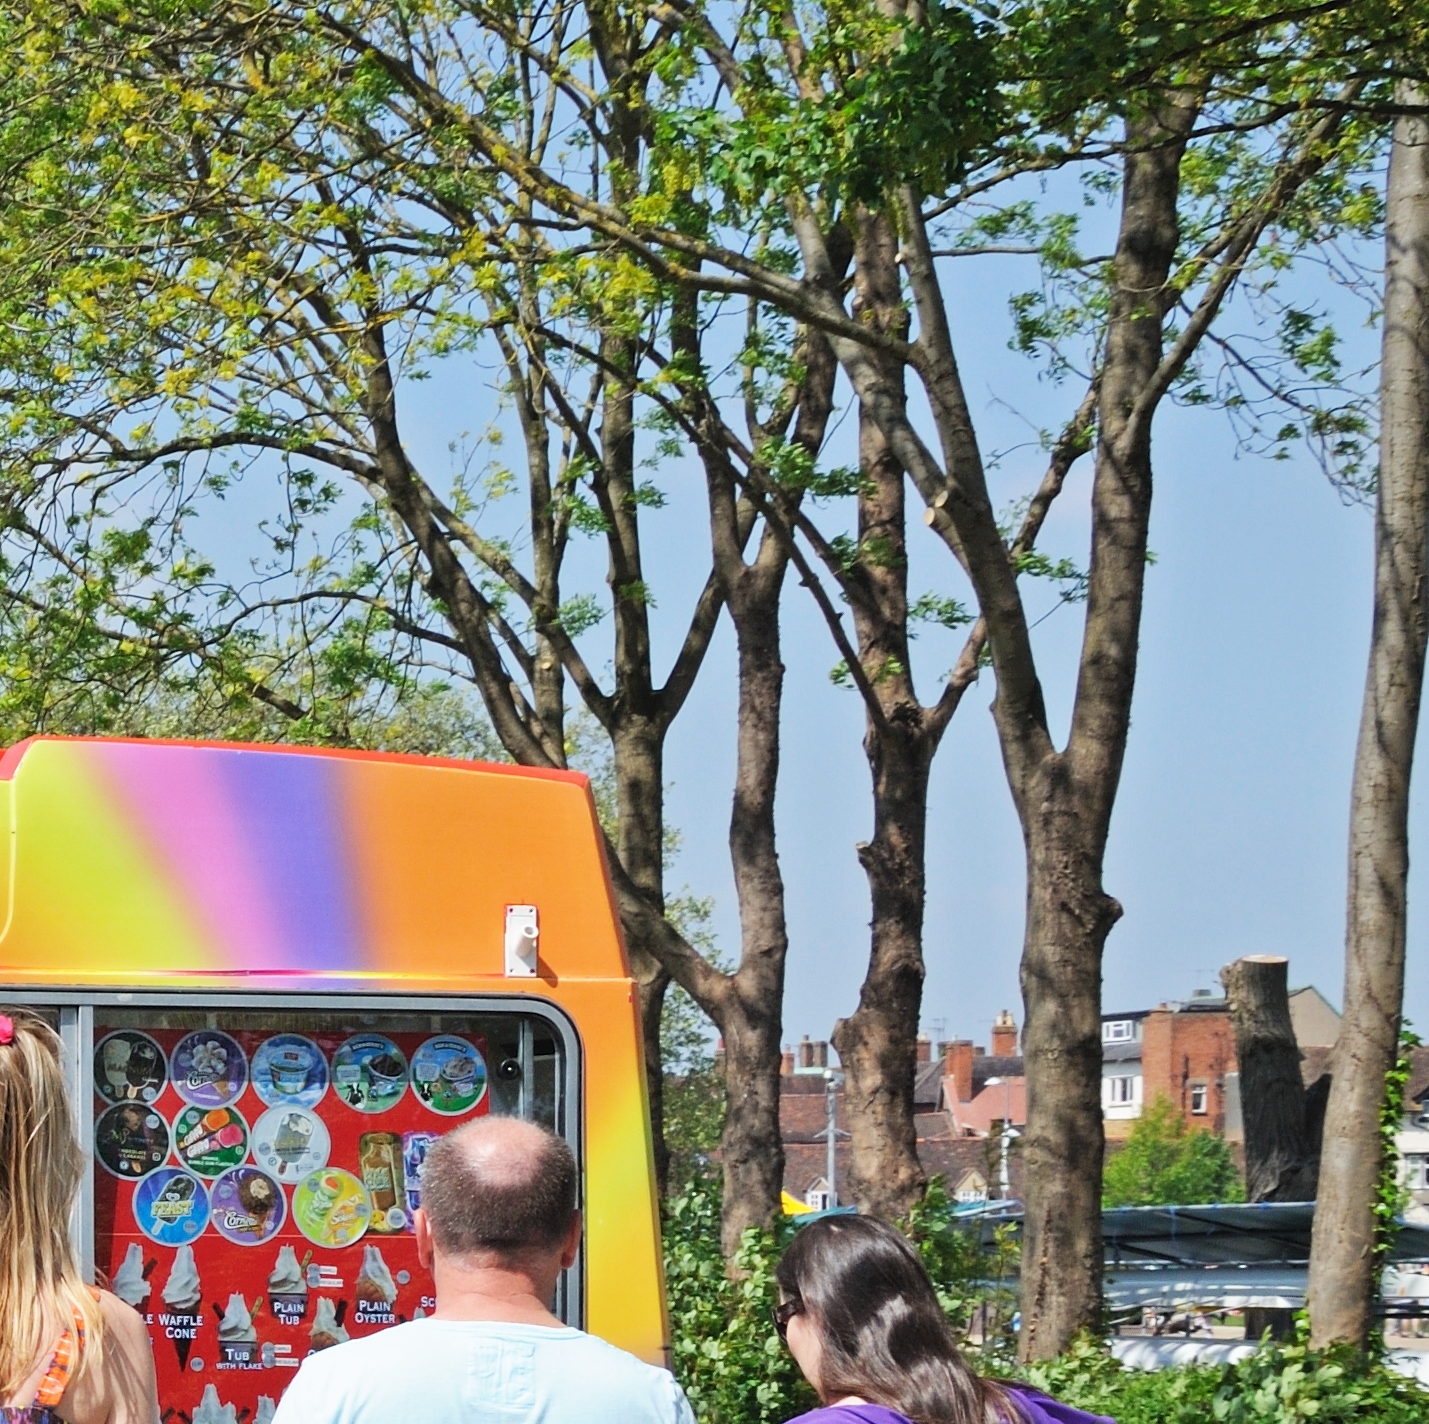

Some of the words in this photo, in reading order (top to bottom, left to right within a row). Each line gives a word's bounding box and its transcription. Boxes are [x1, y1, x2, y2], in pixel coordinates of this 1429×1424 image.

[151, 1200, 194, 1217] FEAST
[273, 1302, 305, 1313] PLAIN
[359, 1300, 391, 1311] PLAIN
[158, 1313, 204, 1326] WAFFLE
[278, 1314, 300, 1325] TUB
[354, 1312, 395, 1323] OYSTER
[165, 1327, 197, 1339] CONE
[225, 1348, 250, 1361] TUB
[215, 1362, 236, 1370] WITH
[238, 1362, 264, 1370] FLAKE
